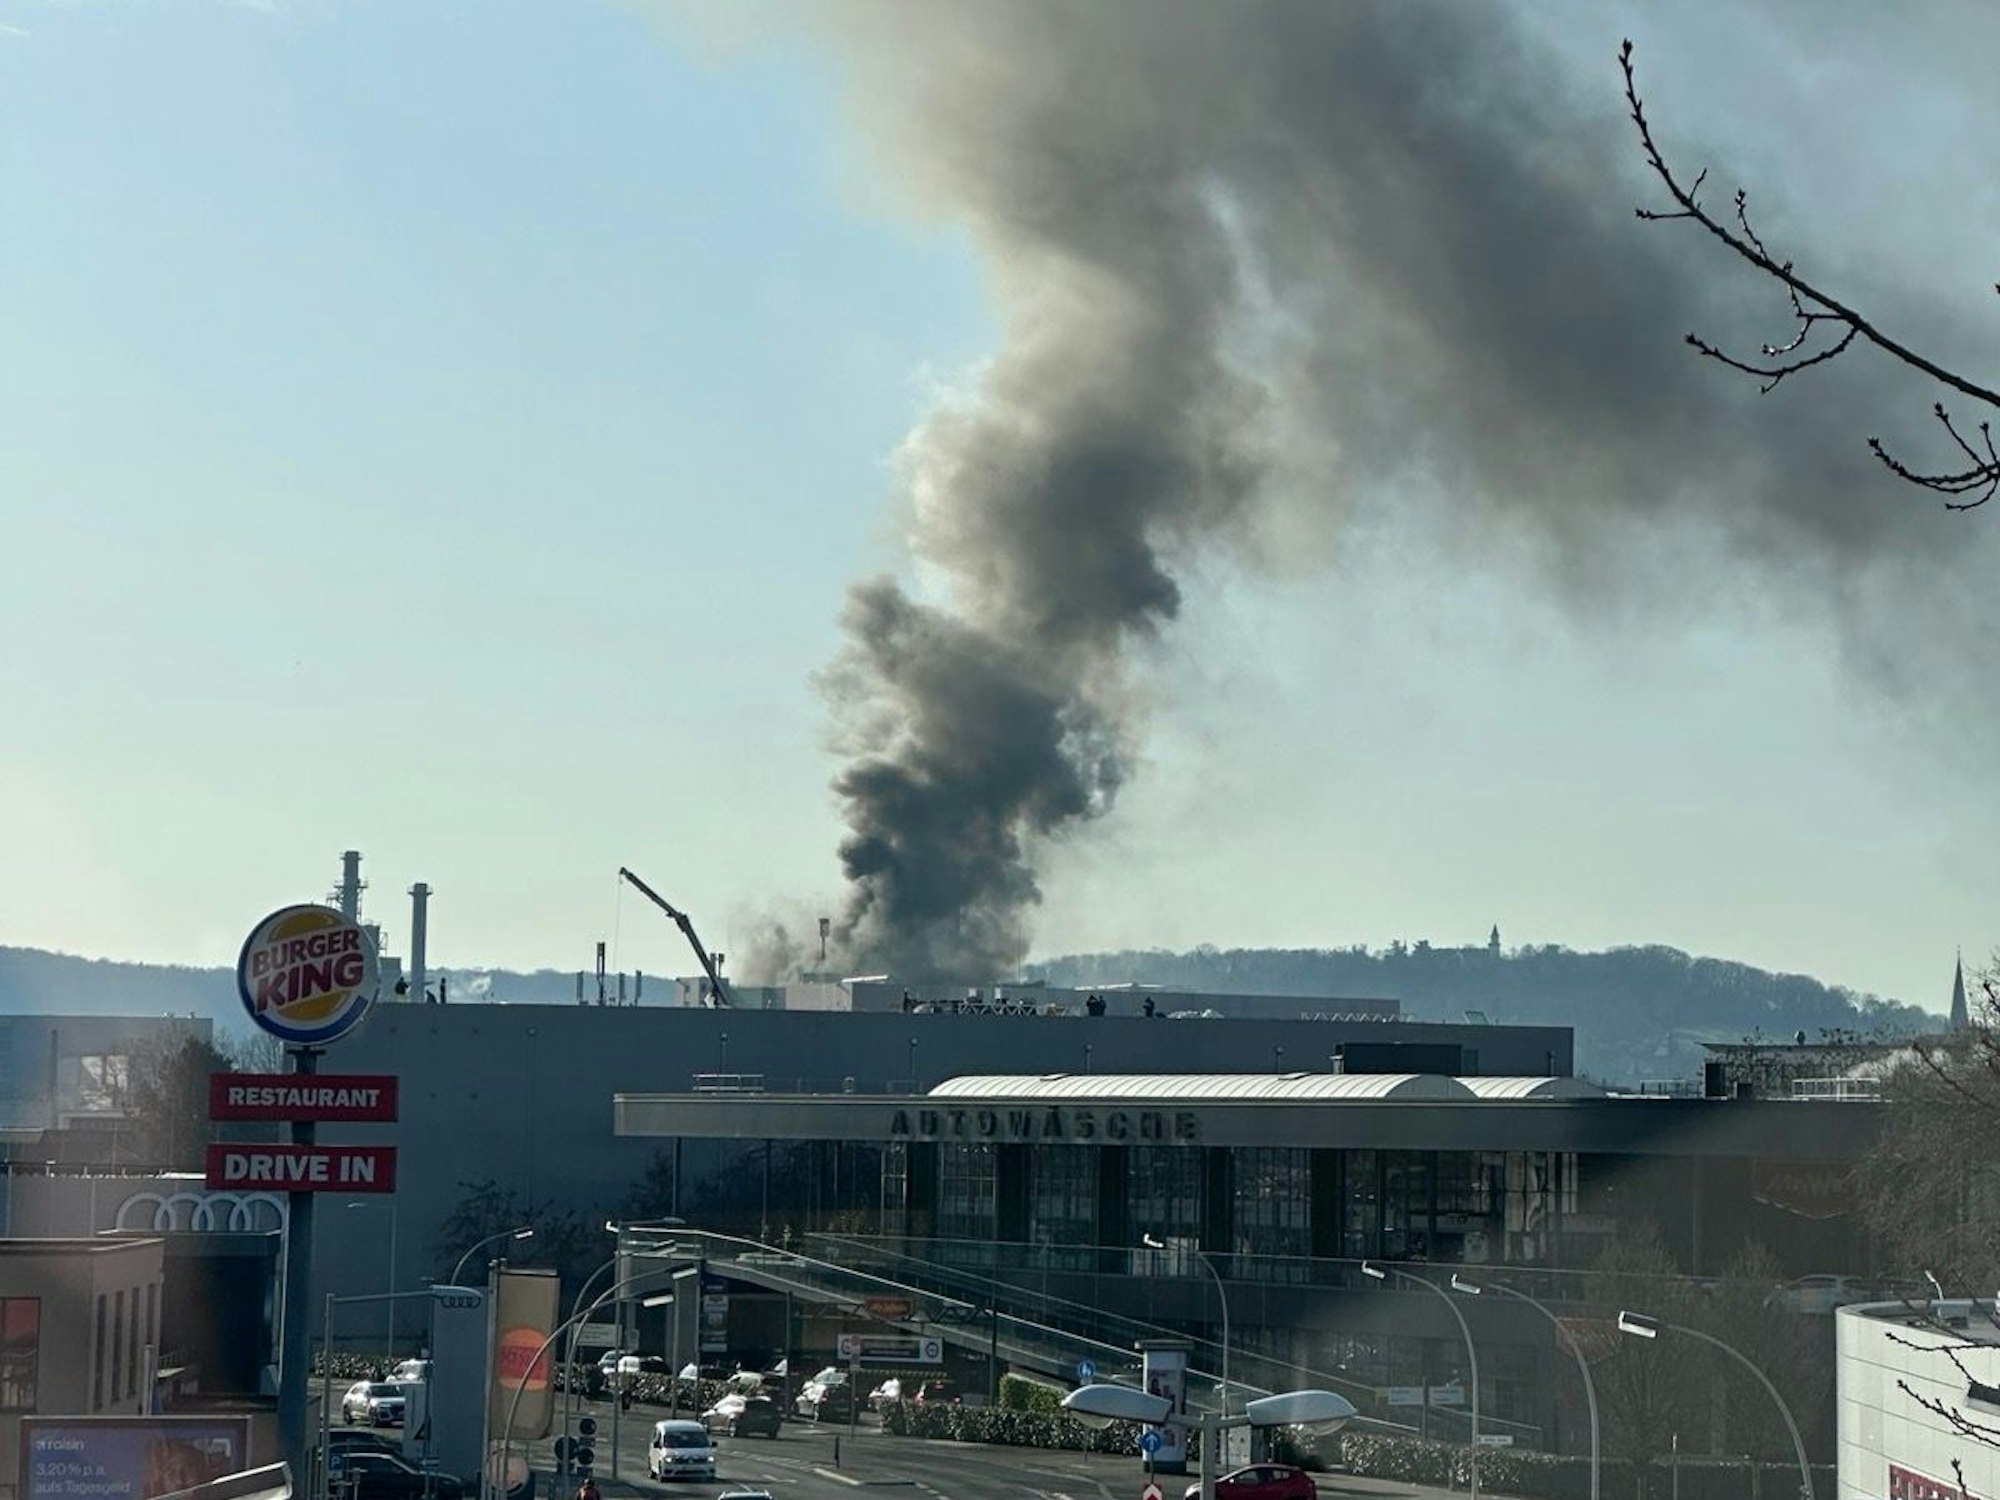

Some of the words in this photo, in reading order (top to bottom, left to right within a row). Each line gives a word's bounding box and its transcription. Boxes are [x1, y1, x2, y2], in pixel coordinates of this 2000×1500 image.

[252, 929, 360, 978] BURGER
[256, 953, 364, 1012] KING
[228, 1087, 381, 1107] RESTAURANT
[890, 1105, 1197, 1139] AUTOWÄSCHE
[224, 1154, 329, 1182] DRIVE
[339, 1155, 375, 1182] IN
